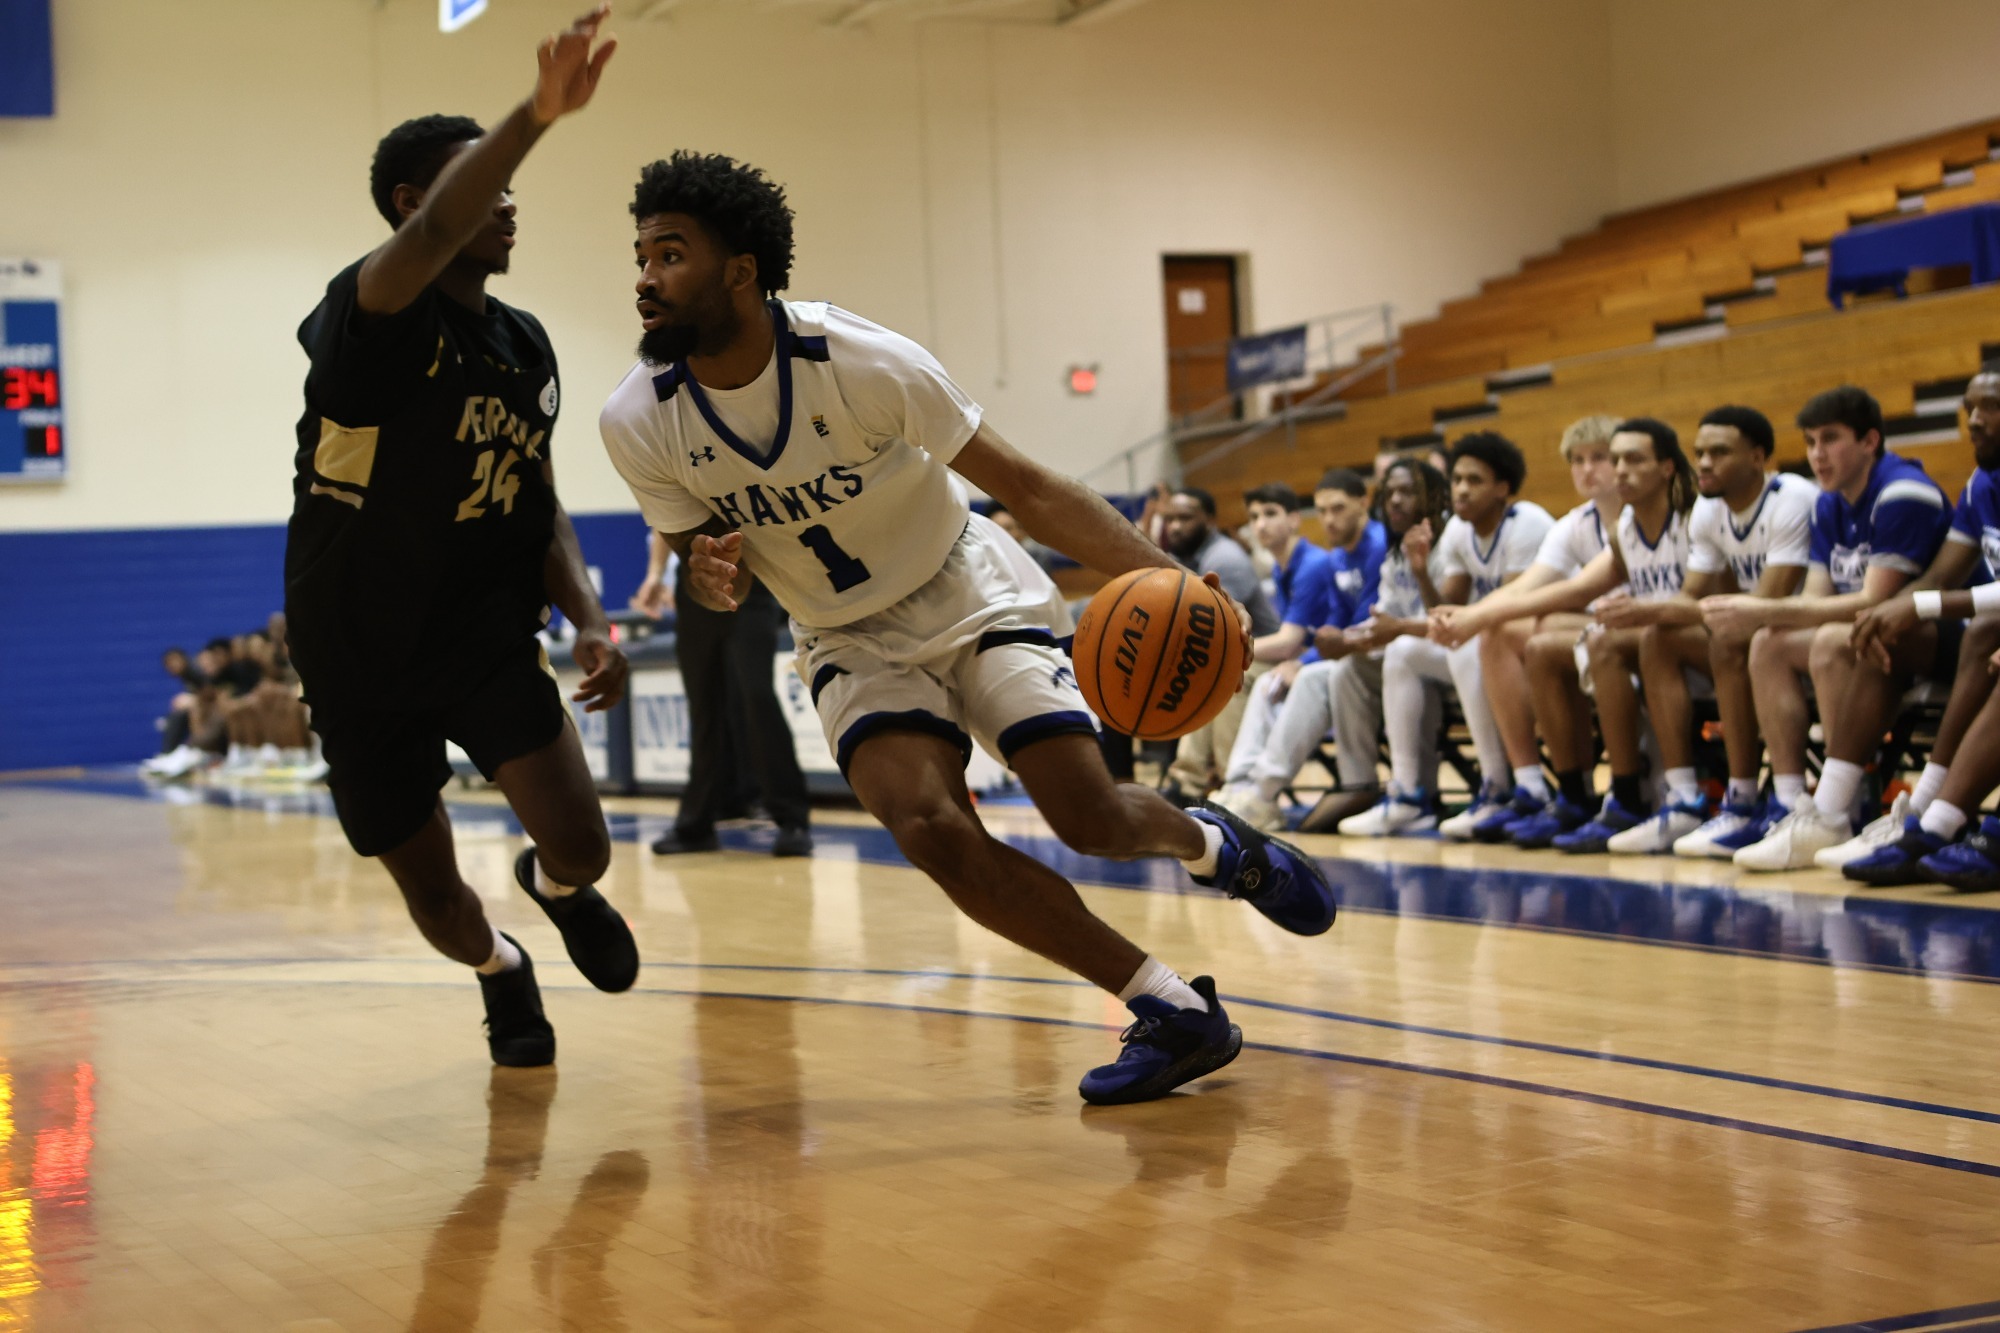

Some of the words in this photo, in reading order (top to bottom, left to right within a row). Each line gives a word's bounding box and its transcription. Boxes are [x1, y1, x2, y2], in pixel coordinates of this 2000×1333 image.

[4, 367, 58, 410] 34
[46, 424, 60, 456] 1
[454, 449, 522, 522] 24
[709, 465, 863, 528] HAWKS
[797, 523, 872, 593] 1
[1114, 604, 1150, 676] EVO
[1156, 602, 1215, 713] Wilson
